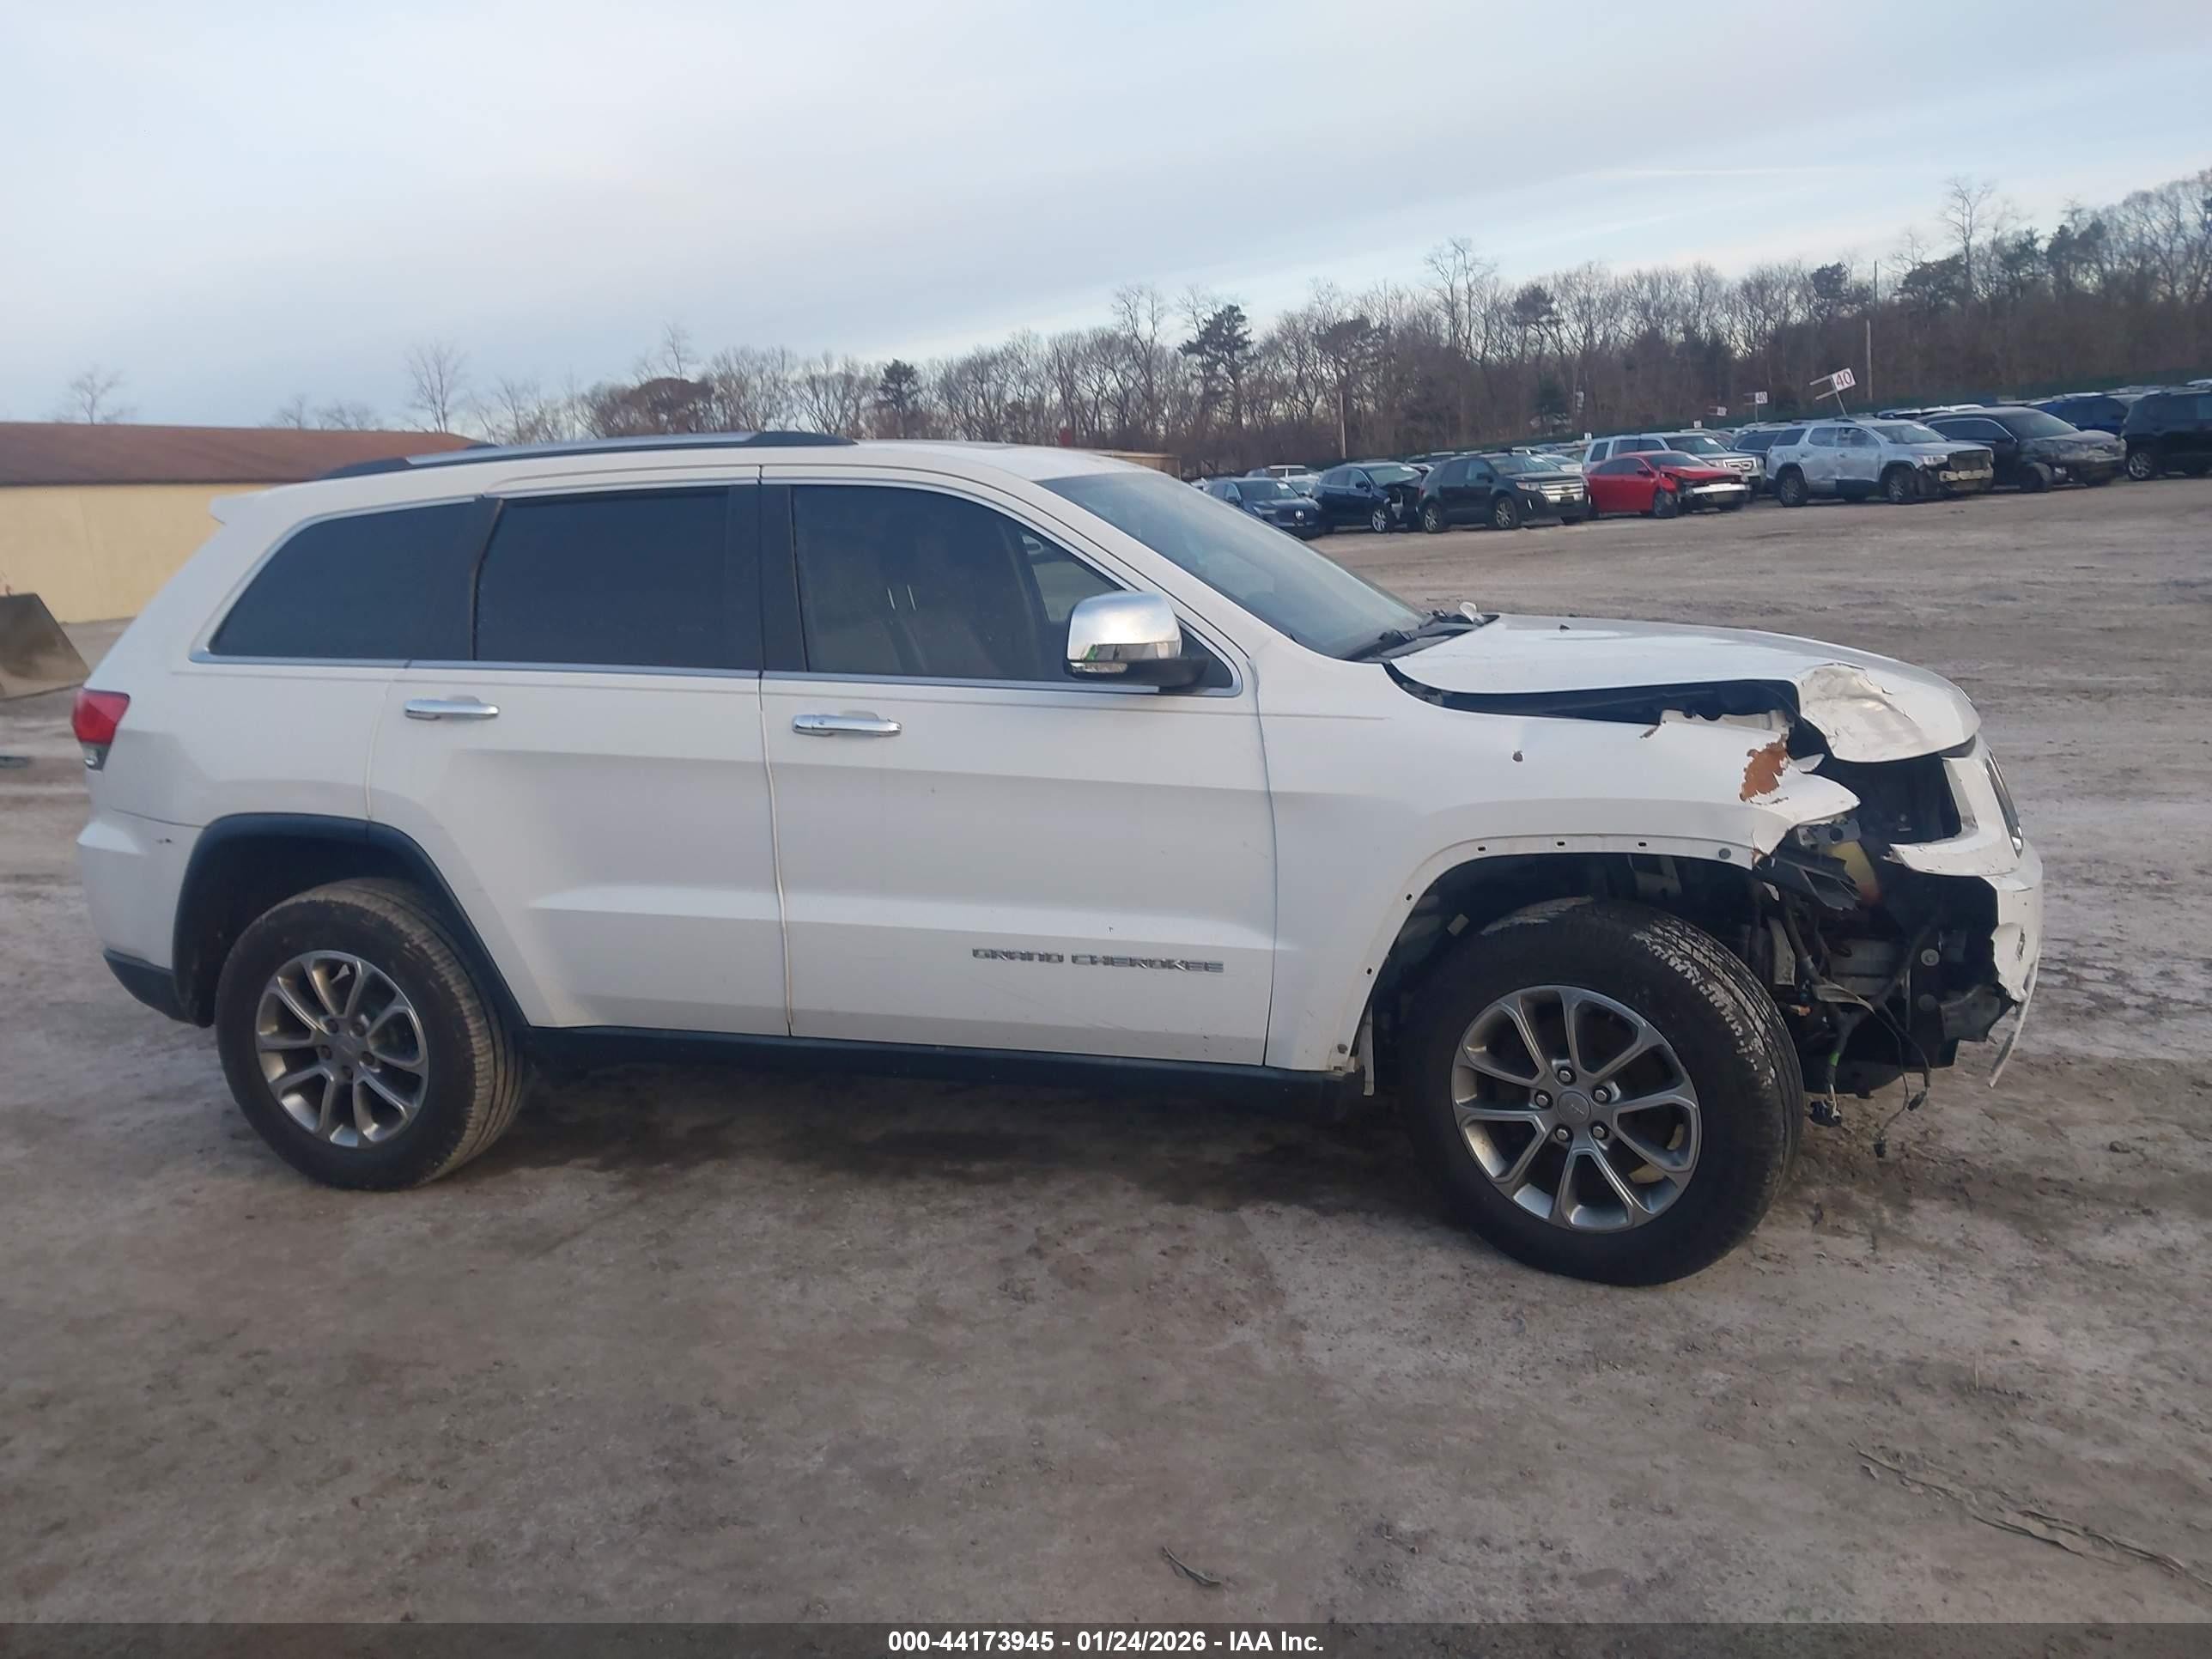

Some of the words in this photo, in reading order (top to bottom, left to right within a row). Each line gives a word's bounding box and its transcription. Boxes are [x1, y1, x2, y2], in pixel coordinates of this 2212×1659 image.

[1836, 370, 1852, 386] 40
[973, 948, 1064, 963] GRAND
[1071, 953, 1224, 973] CHEROKEE
